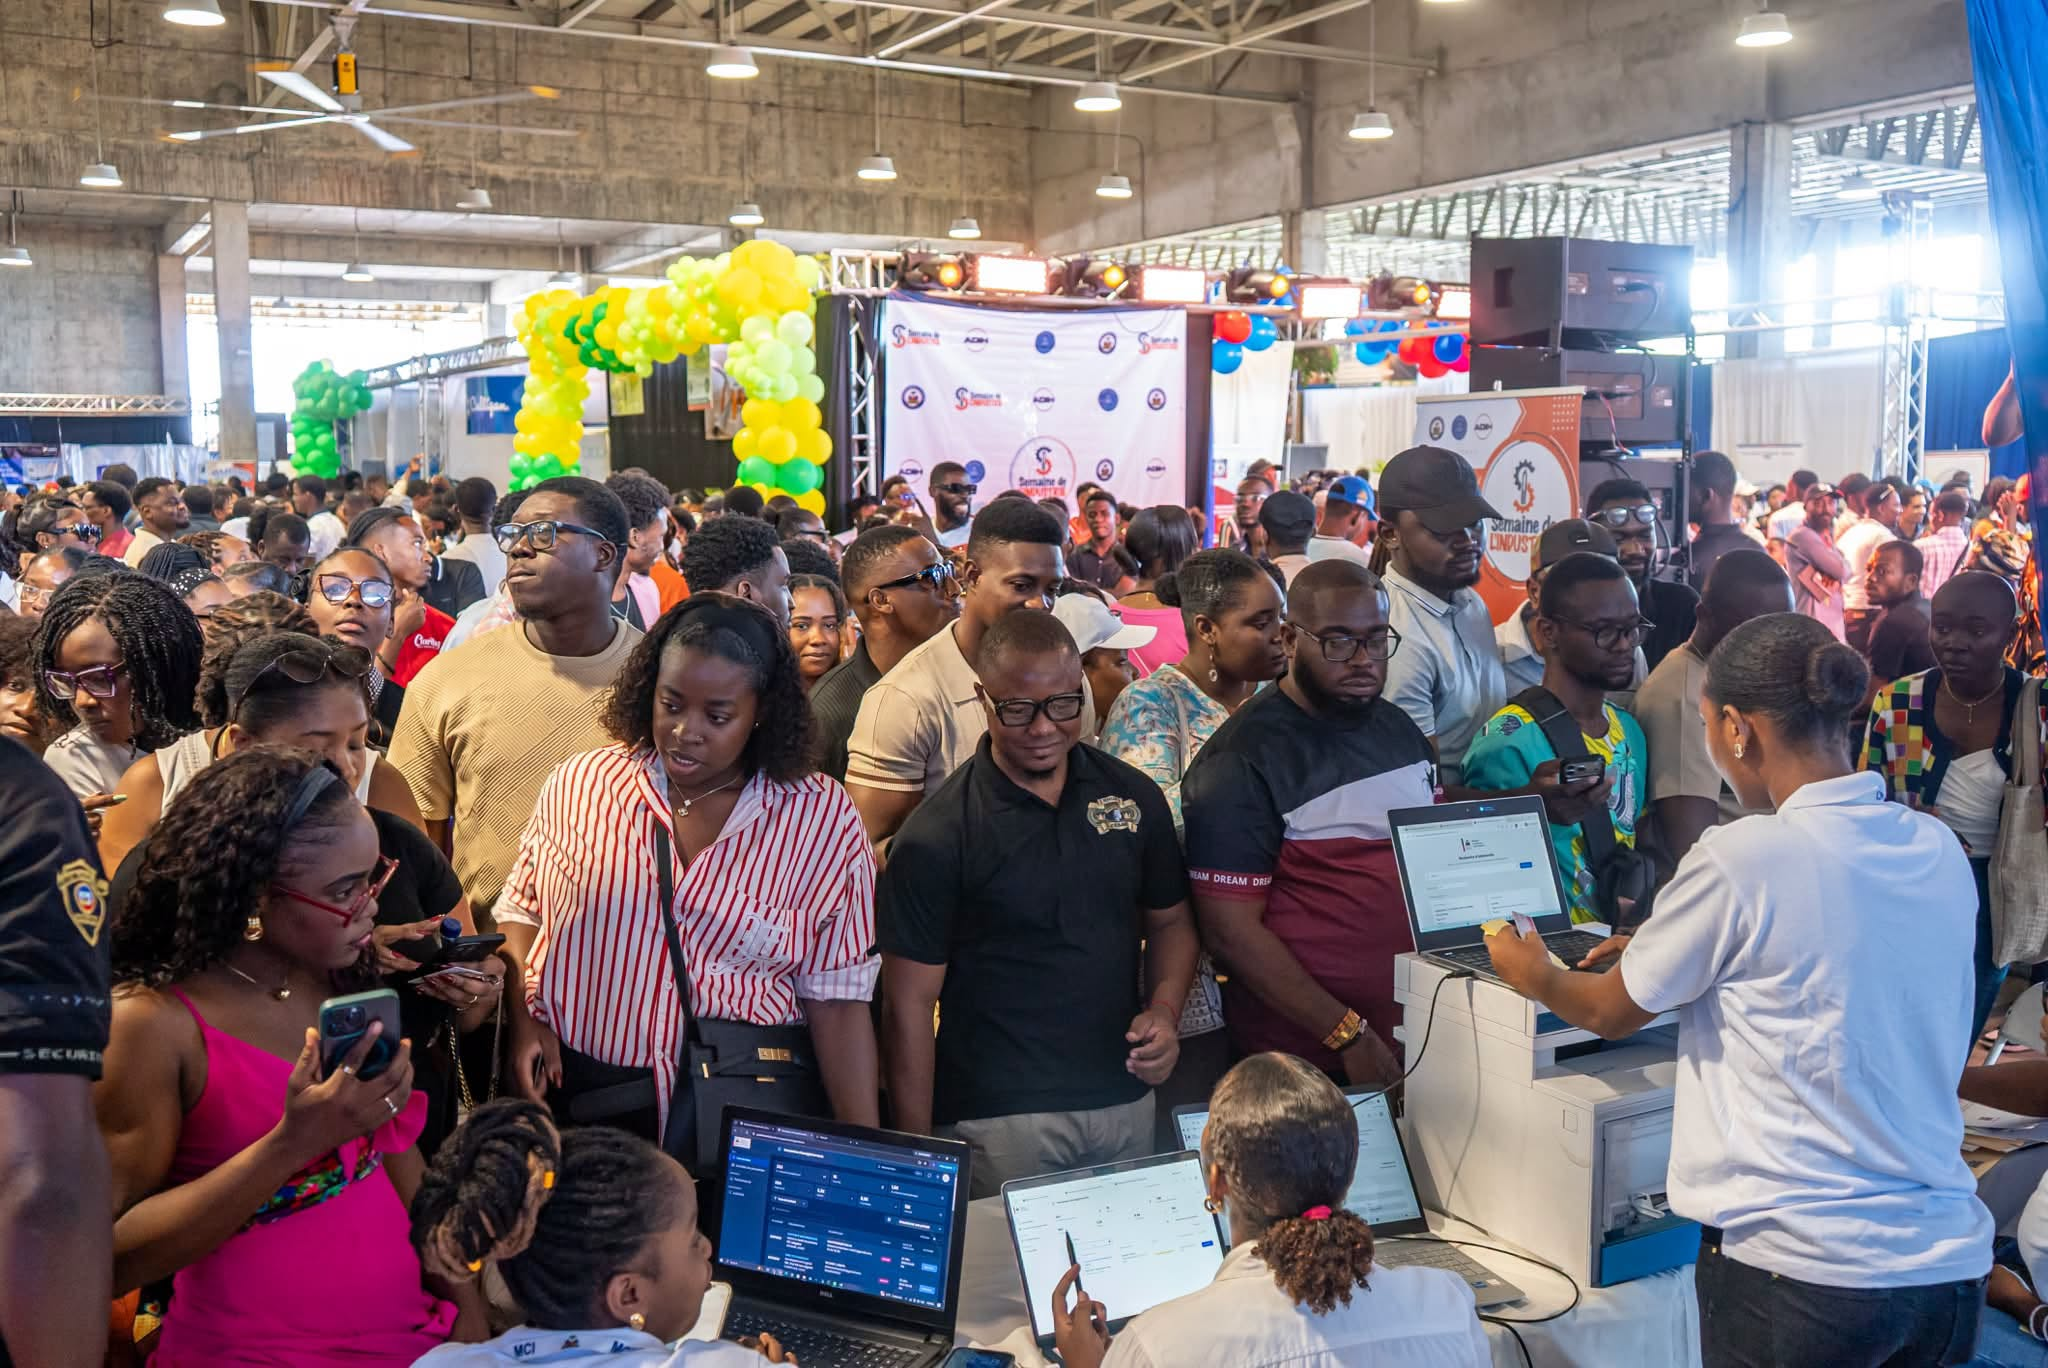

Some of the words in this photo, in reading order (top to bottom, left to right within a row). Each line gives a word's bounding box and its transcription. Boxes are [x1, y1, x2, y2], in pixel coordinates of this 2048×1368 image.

[1491, 515, 1540, 533] Semaine
[1490, 532, 1537, 553] L'INDUST
[1213, 873, 1248, 886] DREAM
[513, 1341, 536, 1357] MCI
